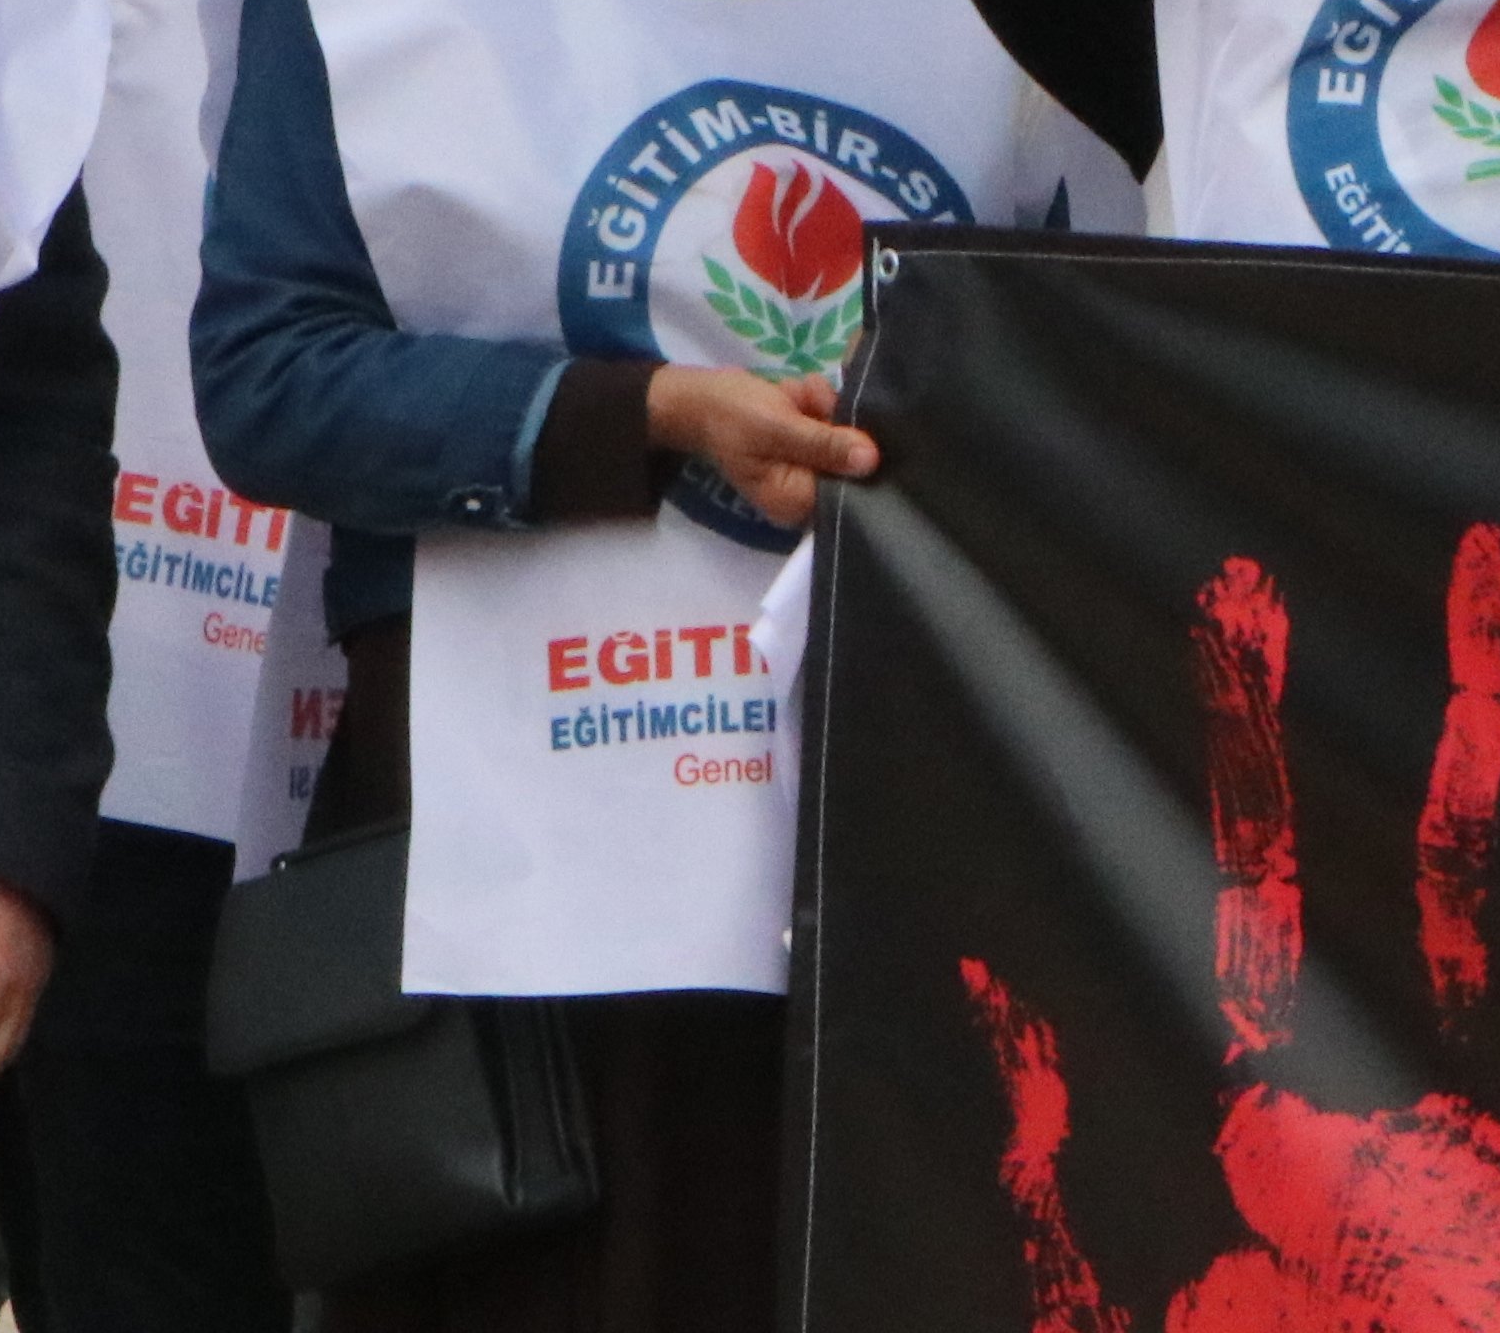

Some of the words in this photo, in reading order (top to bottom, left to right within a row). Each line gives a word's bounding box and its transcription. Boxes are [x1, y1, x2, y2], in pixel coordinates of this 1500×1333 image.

[587, 96, 957, 303] EĞİTİM-BİR-S
[116, 540, 281, 609] ĞİTİMCİLE
[202, 611, 270, 656] Gene
[547, 623, 771, 693] EĞİTİ
[673, 750, 773, 787] Genel
